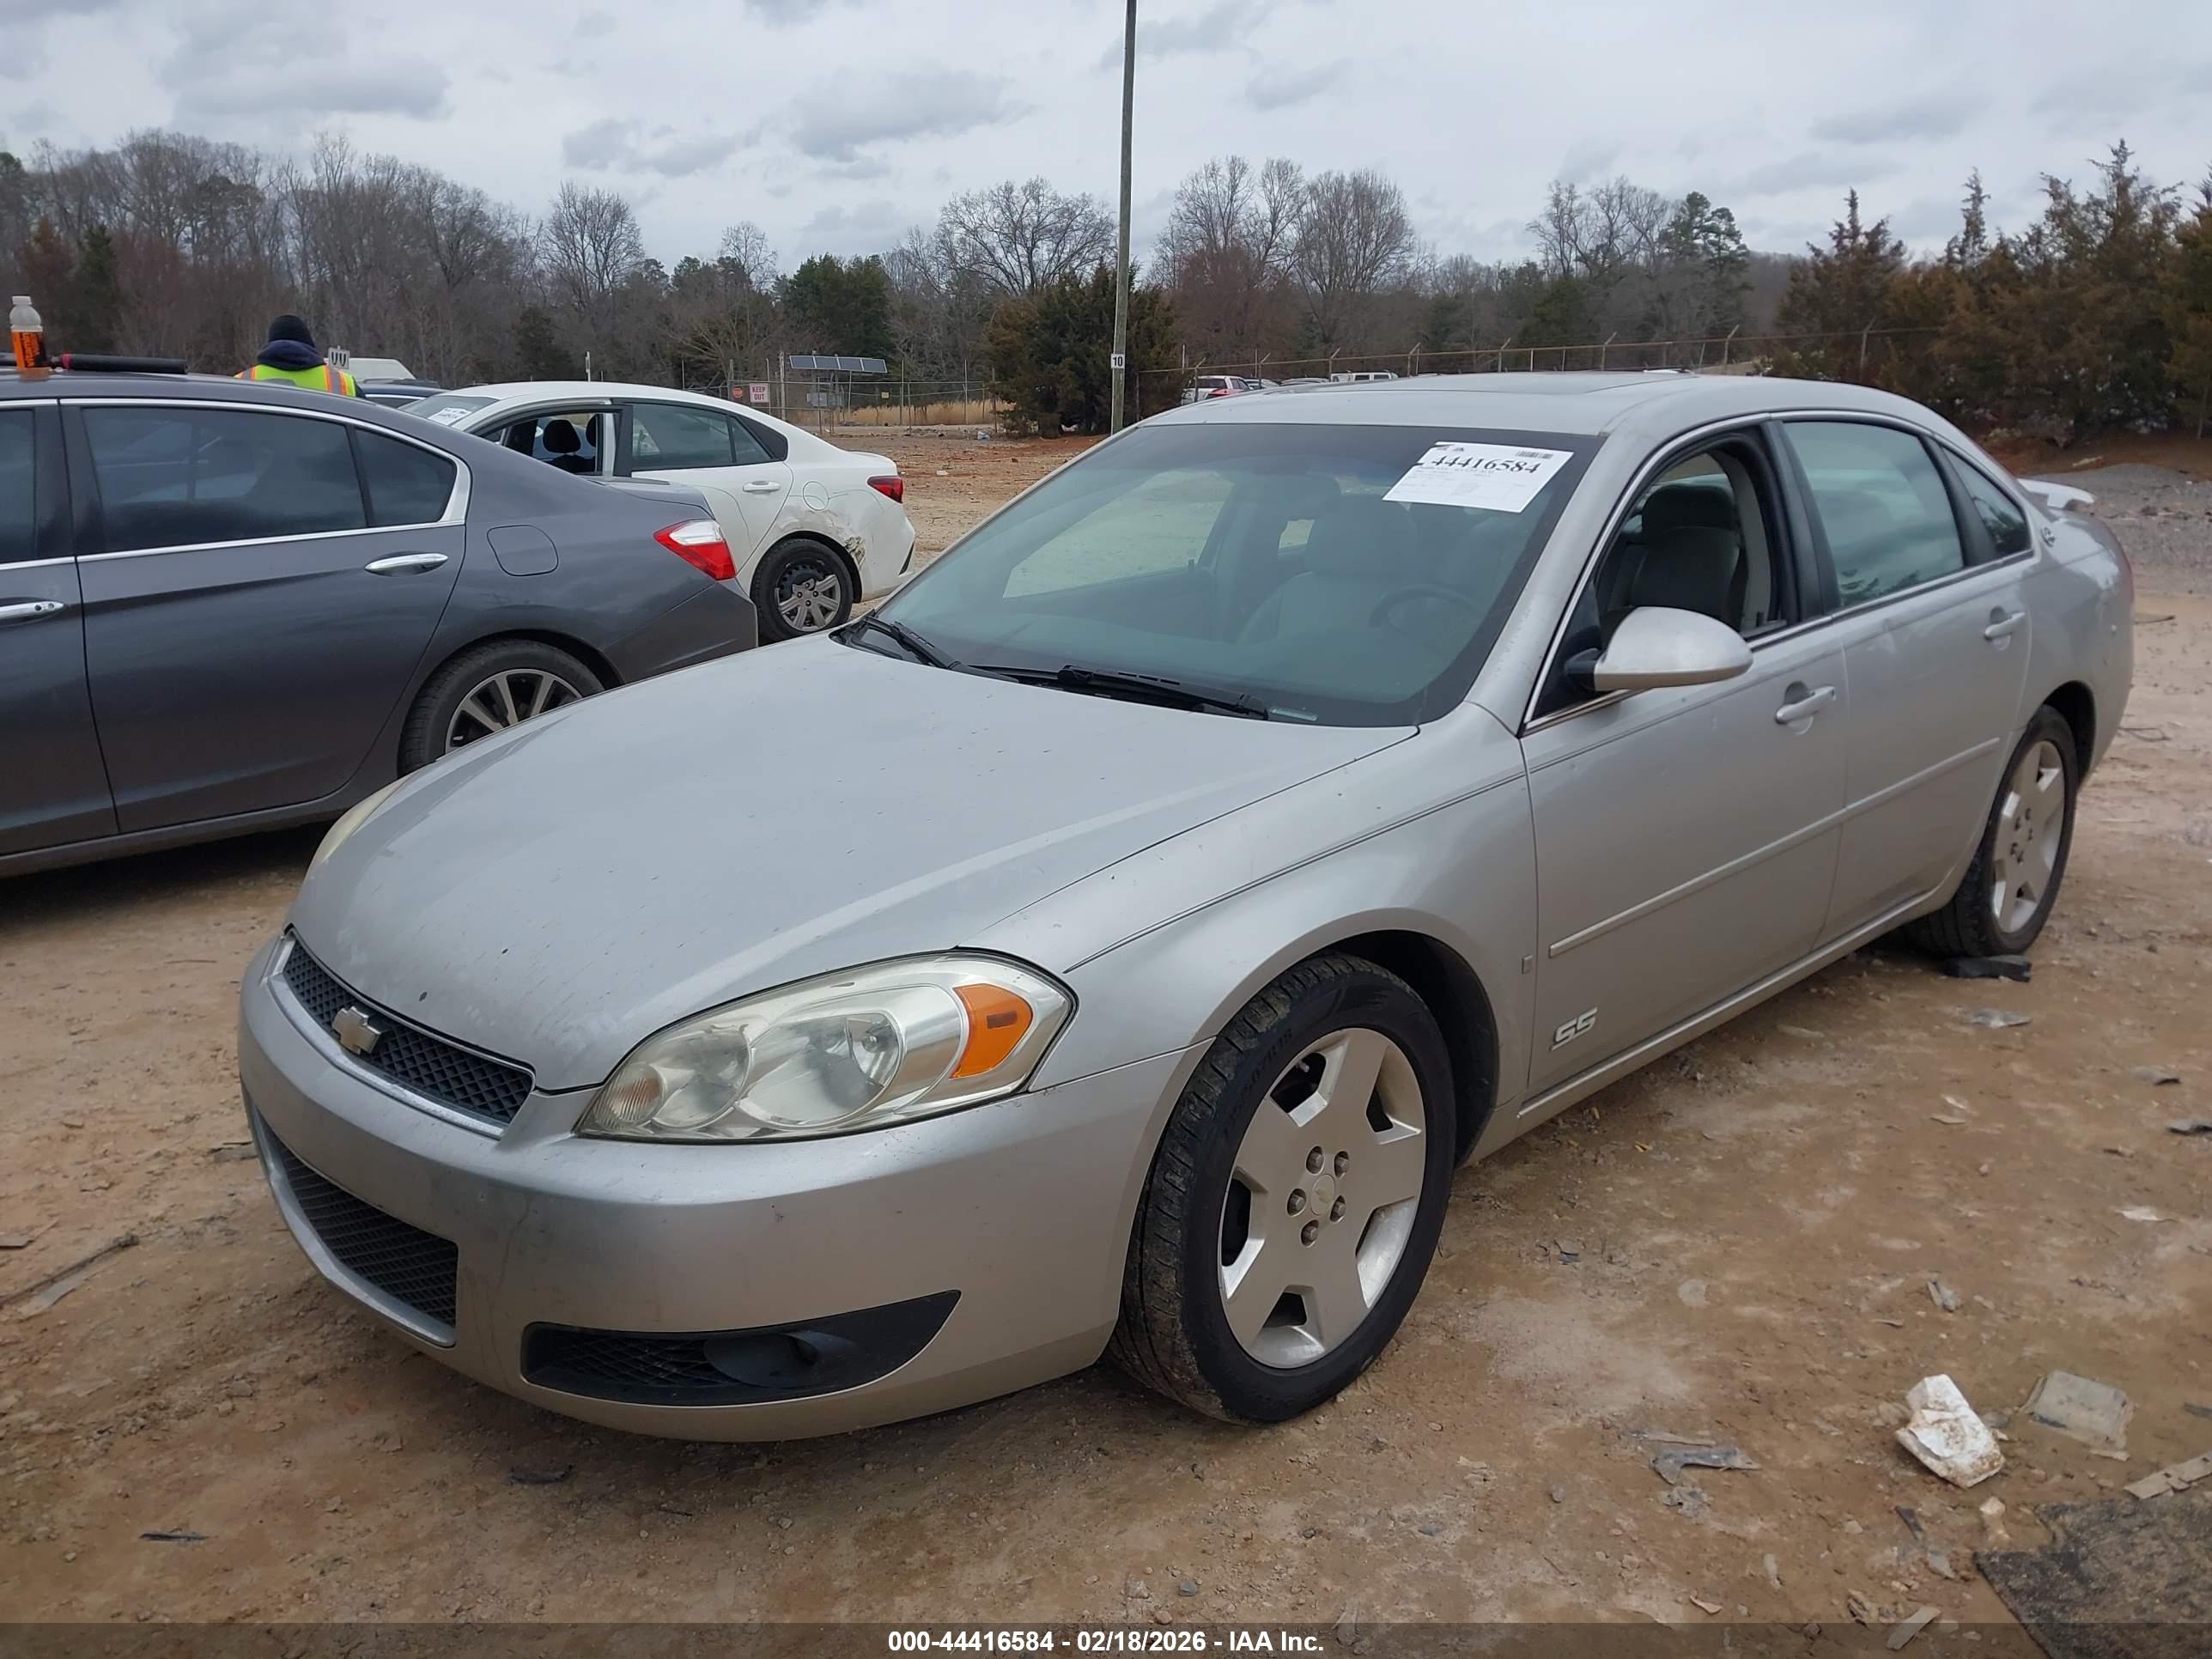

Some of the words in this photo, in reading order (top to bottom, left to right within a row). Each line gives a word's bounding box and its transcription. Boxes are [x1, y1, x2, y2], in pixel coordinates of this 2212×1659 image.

[1113, 356, 1123, 367] 10
[1431, 455, 1541, 473] 44416584
[1549, 1006, 1598, 1051] SS
